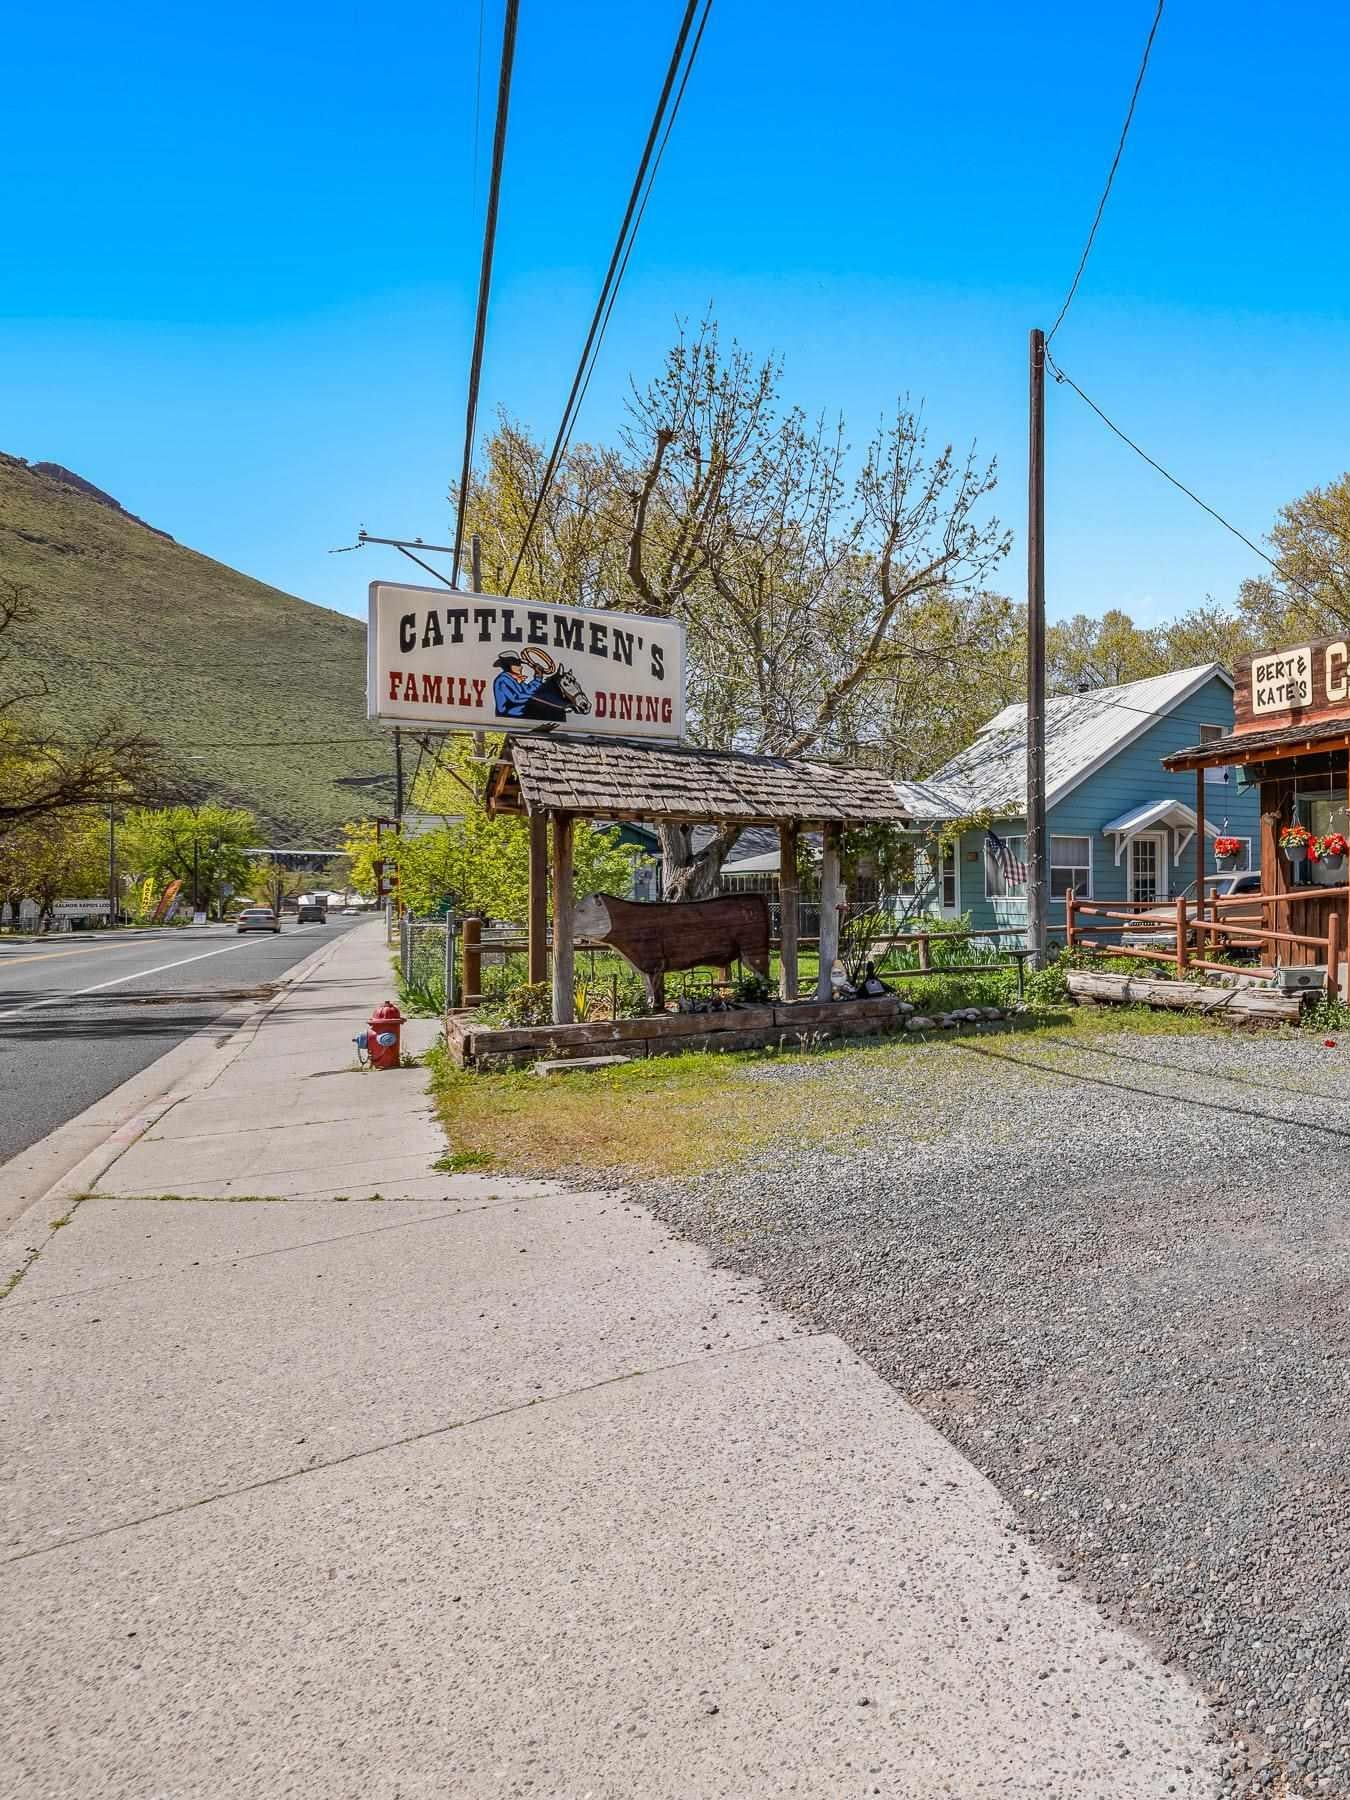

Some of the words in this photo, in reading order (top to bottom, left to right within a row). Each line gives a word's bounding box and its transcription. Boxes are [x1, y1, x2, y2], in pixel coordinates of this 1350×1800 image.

[399, 608, 665, 681] CATTLEMEN'S
[388, 671, 487, 708] FAMILY
[595, 690, 673, 724] DINING
[1256, 680, 1307, 707] KATE'S
